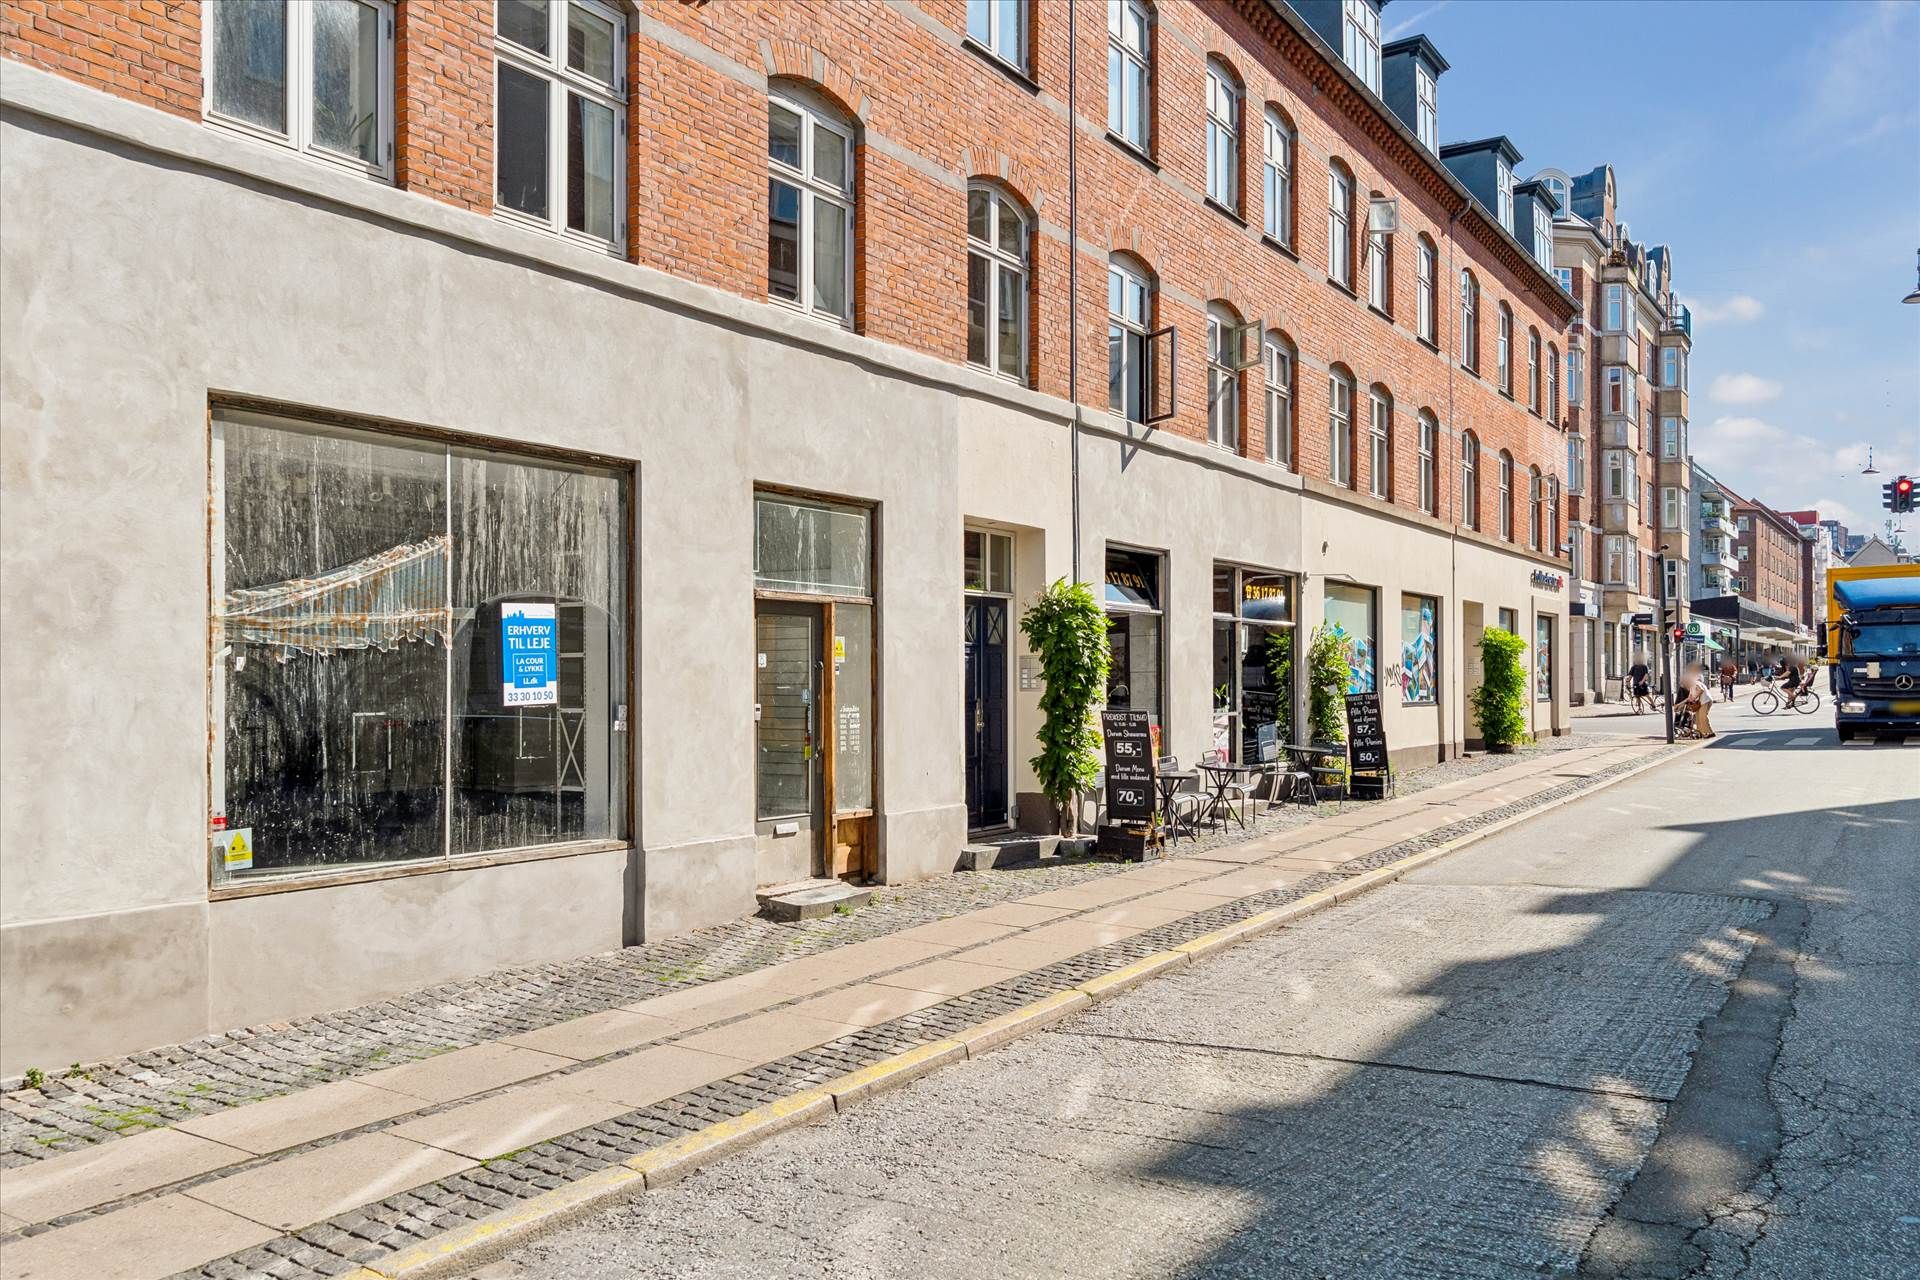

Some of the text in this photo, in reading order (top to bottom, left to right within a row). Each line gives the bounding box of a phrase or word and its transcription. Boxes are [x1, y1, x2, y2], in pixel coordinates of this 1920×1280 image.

[508, 625, 551, 635] ERHVERV
[509, 637, 551, 649] TIL LEJE
[525, 657, 544, 665] COUR
[524, 665, 544, 673] LYKKE
[508, 690, 554, 702] 33 30 10 50
[1357, 725, 1375, 735] 57,-
[1116, 743, 1142, 756] 55,-
[1118, 790, 1143, 806] 70,-
